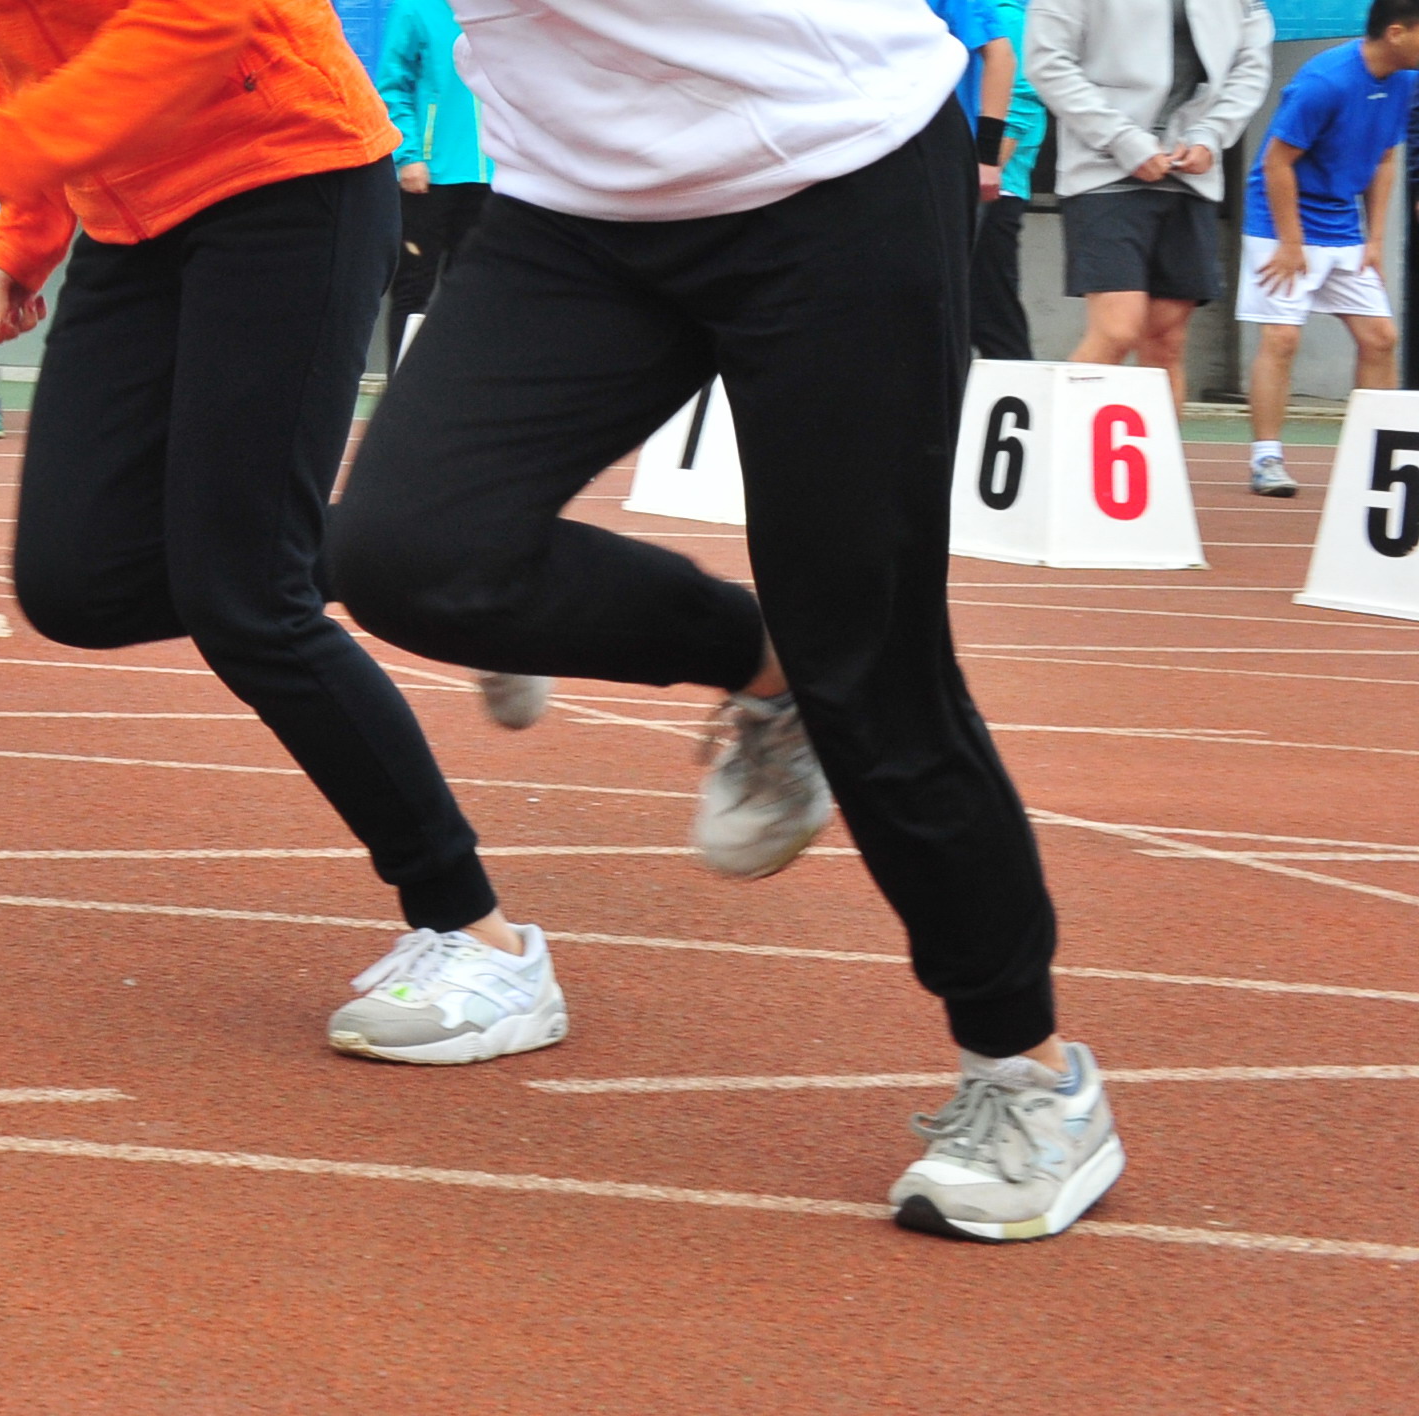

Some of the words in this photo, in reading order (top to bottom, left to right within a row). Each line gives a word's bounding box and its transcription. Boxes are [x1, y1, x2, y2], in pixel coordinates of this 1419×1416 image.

[978, 395, 1031, 511] 6
[1092, 404, 1149, 521] 6
[1366, 428, 1419, 558] 5
